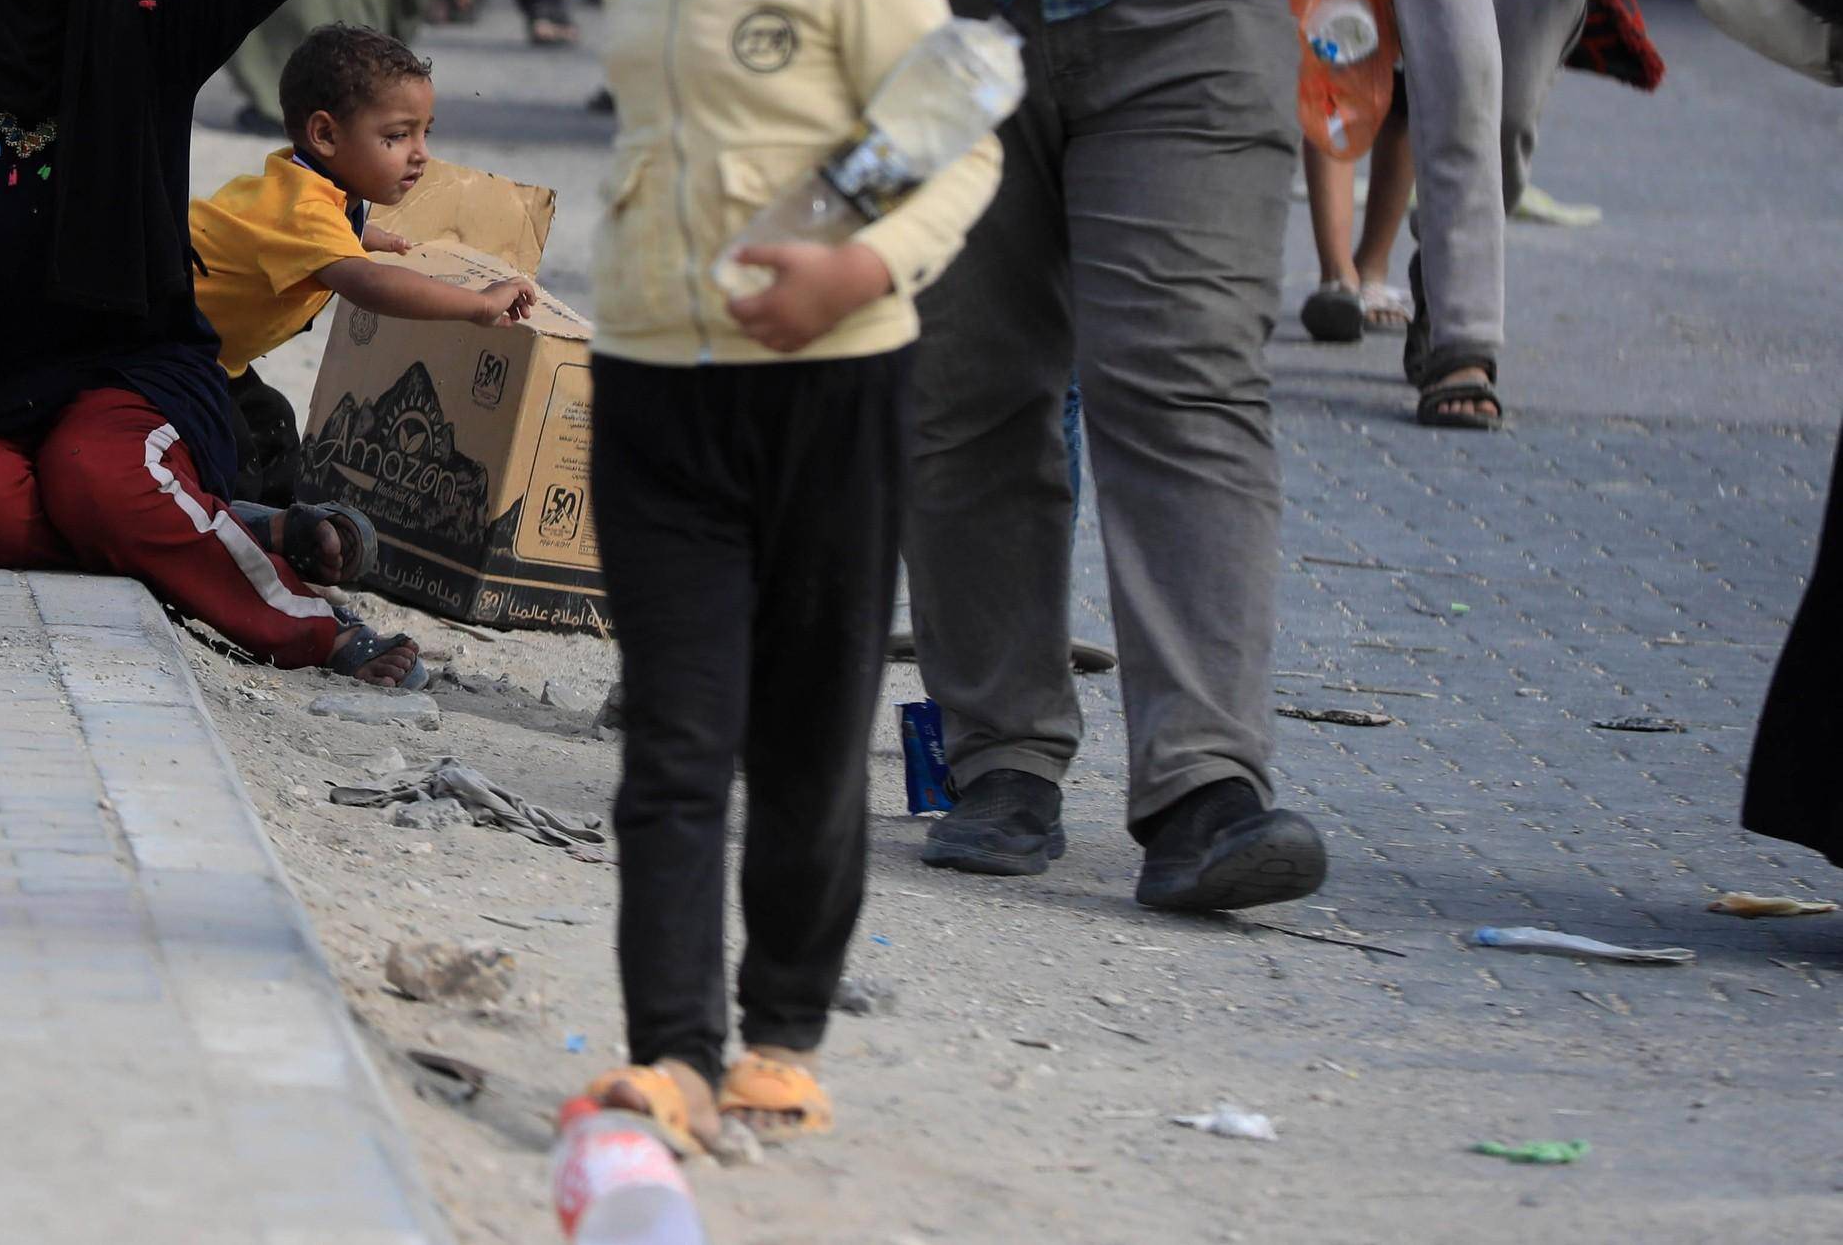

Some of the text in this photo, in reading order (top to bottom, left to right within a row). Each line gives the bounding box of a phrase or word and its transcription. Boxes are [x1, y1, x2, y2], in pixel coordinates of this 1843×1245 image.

[313, 411, 456, 505] Amazon
[549, 488, 577, 518] 50
[384, 565, 425, 591] شرب
[427, 579, 462, 610] مياه
